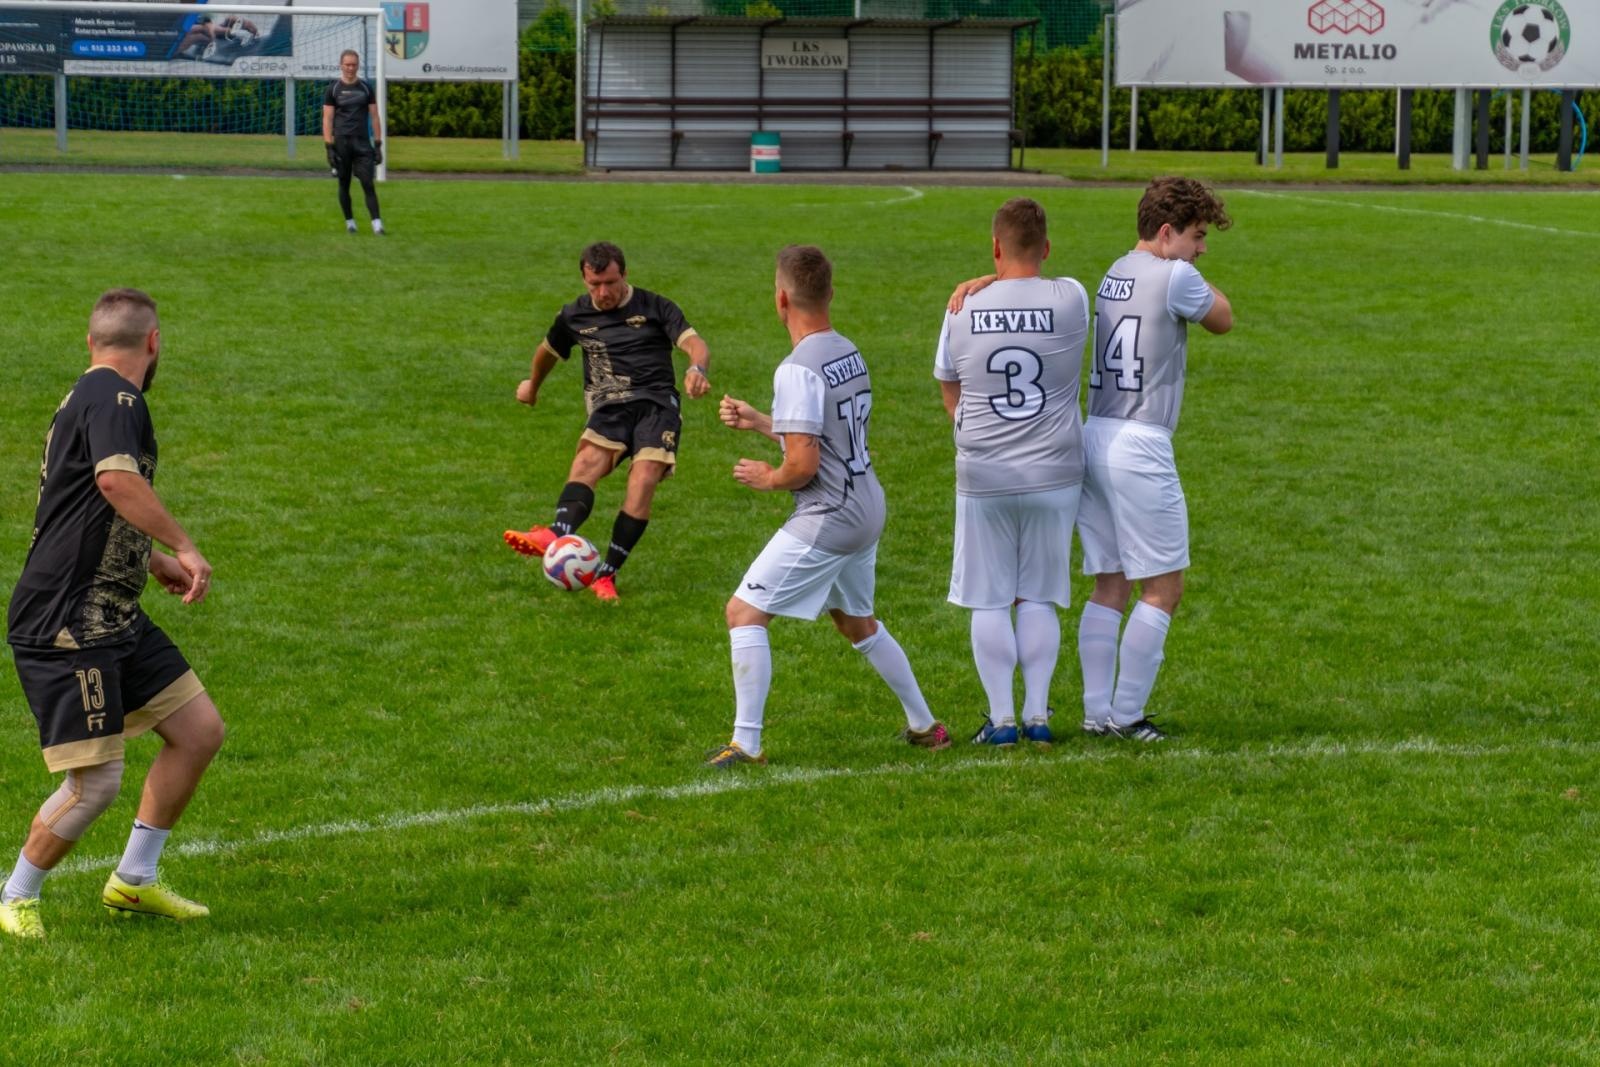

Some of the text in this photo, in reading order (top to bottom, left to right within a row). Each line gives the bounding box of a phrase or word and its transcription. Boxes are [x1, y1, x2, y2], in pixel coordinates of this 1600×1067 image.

[792, 41, 820, 52] LKS
[1294, 43, 1397, 60] METALIO
[1098, 275, 1135, 301] ENIS
[971, 308, 1054, 334] KEVIN
[1090, 312, 1144, 392] 14
[821, 351, 867, 388] STEFAN
[987, 346, 1046, 421] 3
[75, 667, 106, 712] 13
